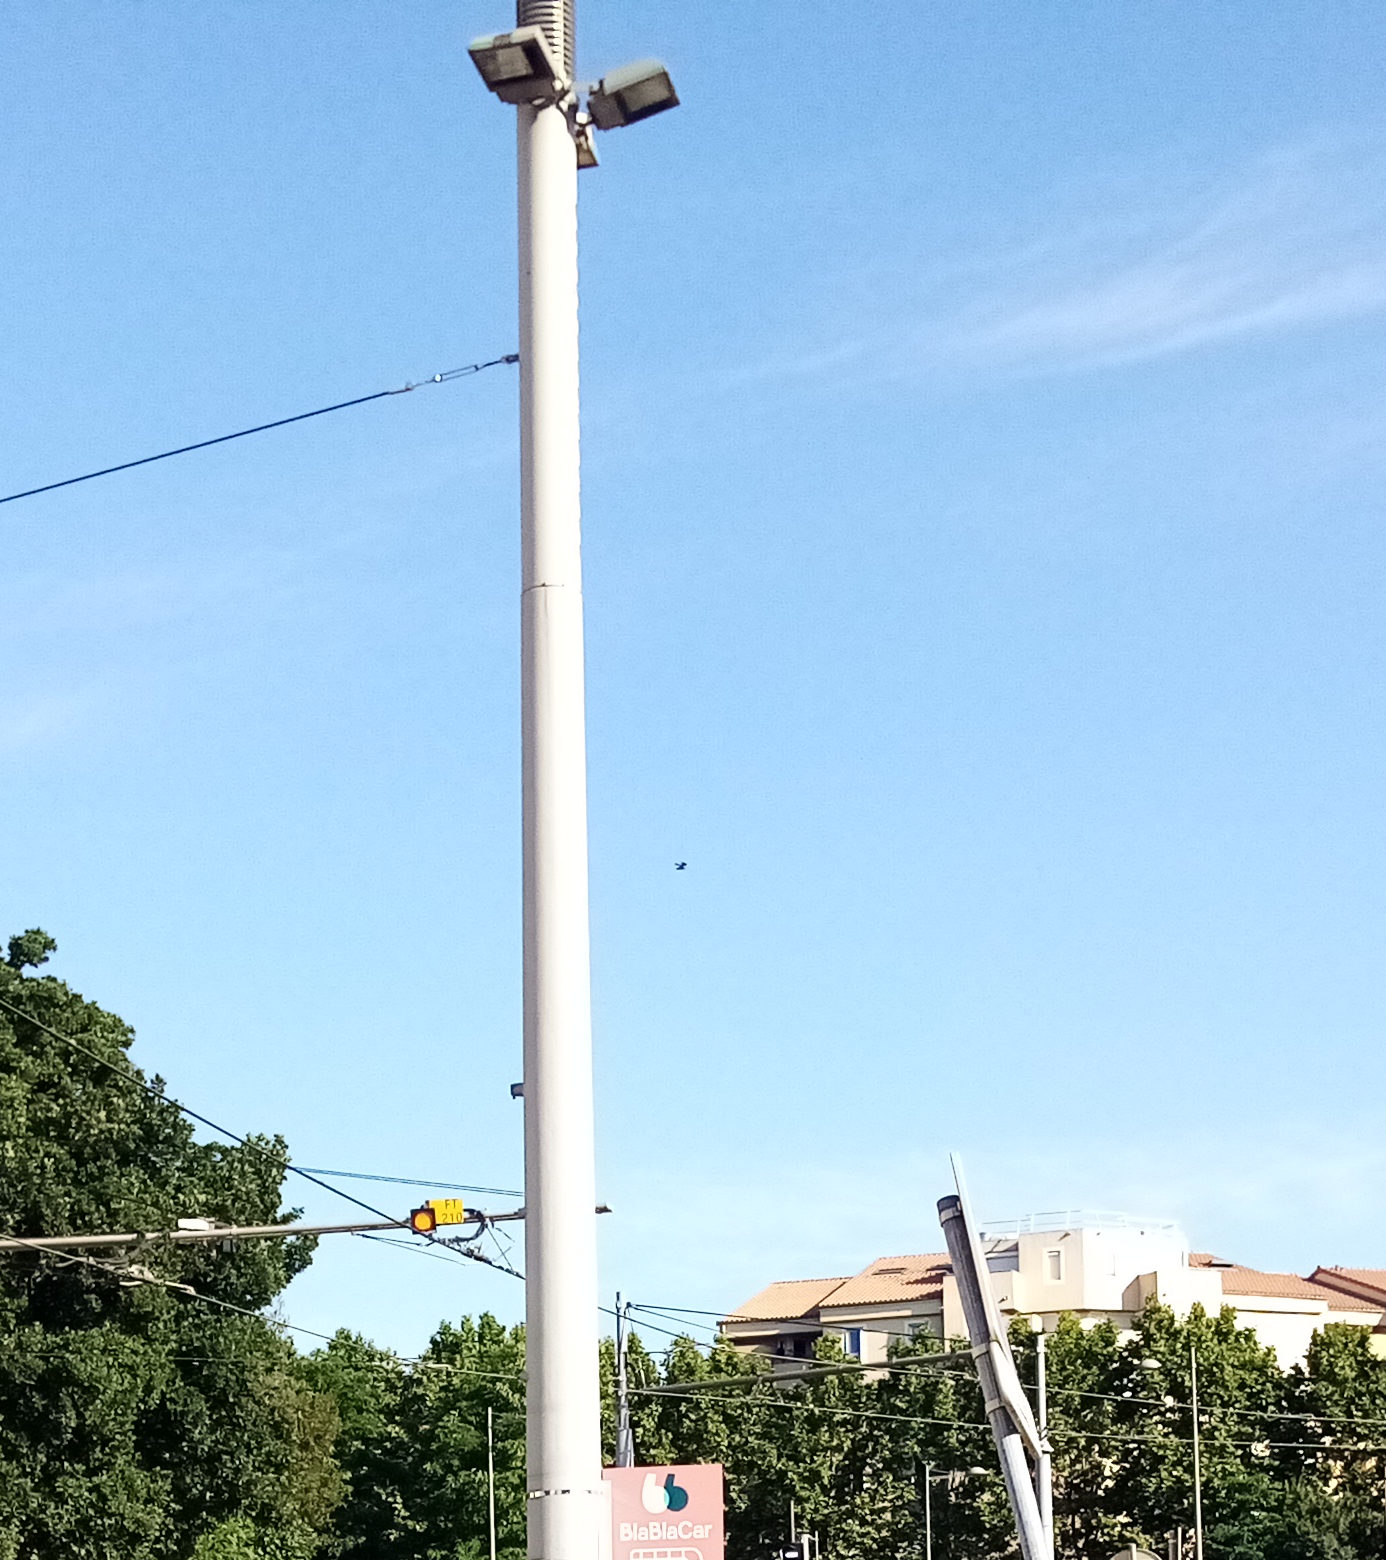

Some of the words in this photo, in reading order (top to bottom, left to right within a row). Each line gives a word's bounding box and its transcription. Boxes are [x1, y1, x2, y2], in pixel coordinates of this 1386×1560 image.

[445, 1199, 458, 1209] FT
[442, 1212, 463, 1223] 210
[620, 1521, 713, 1541] BlaBlaCar
